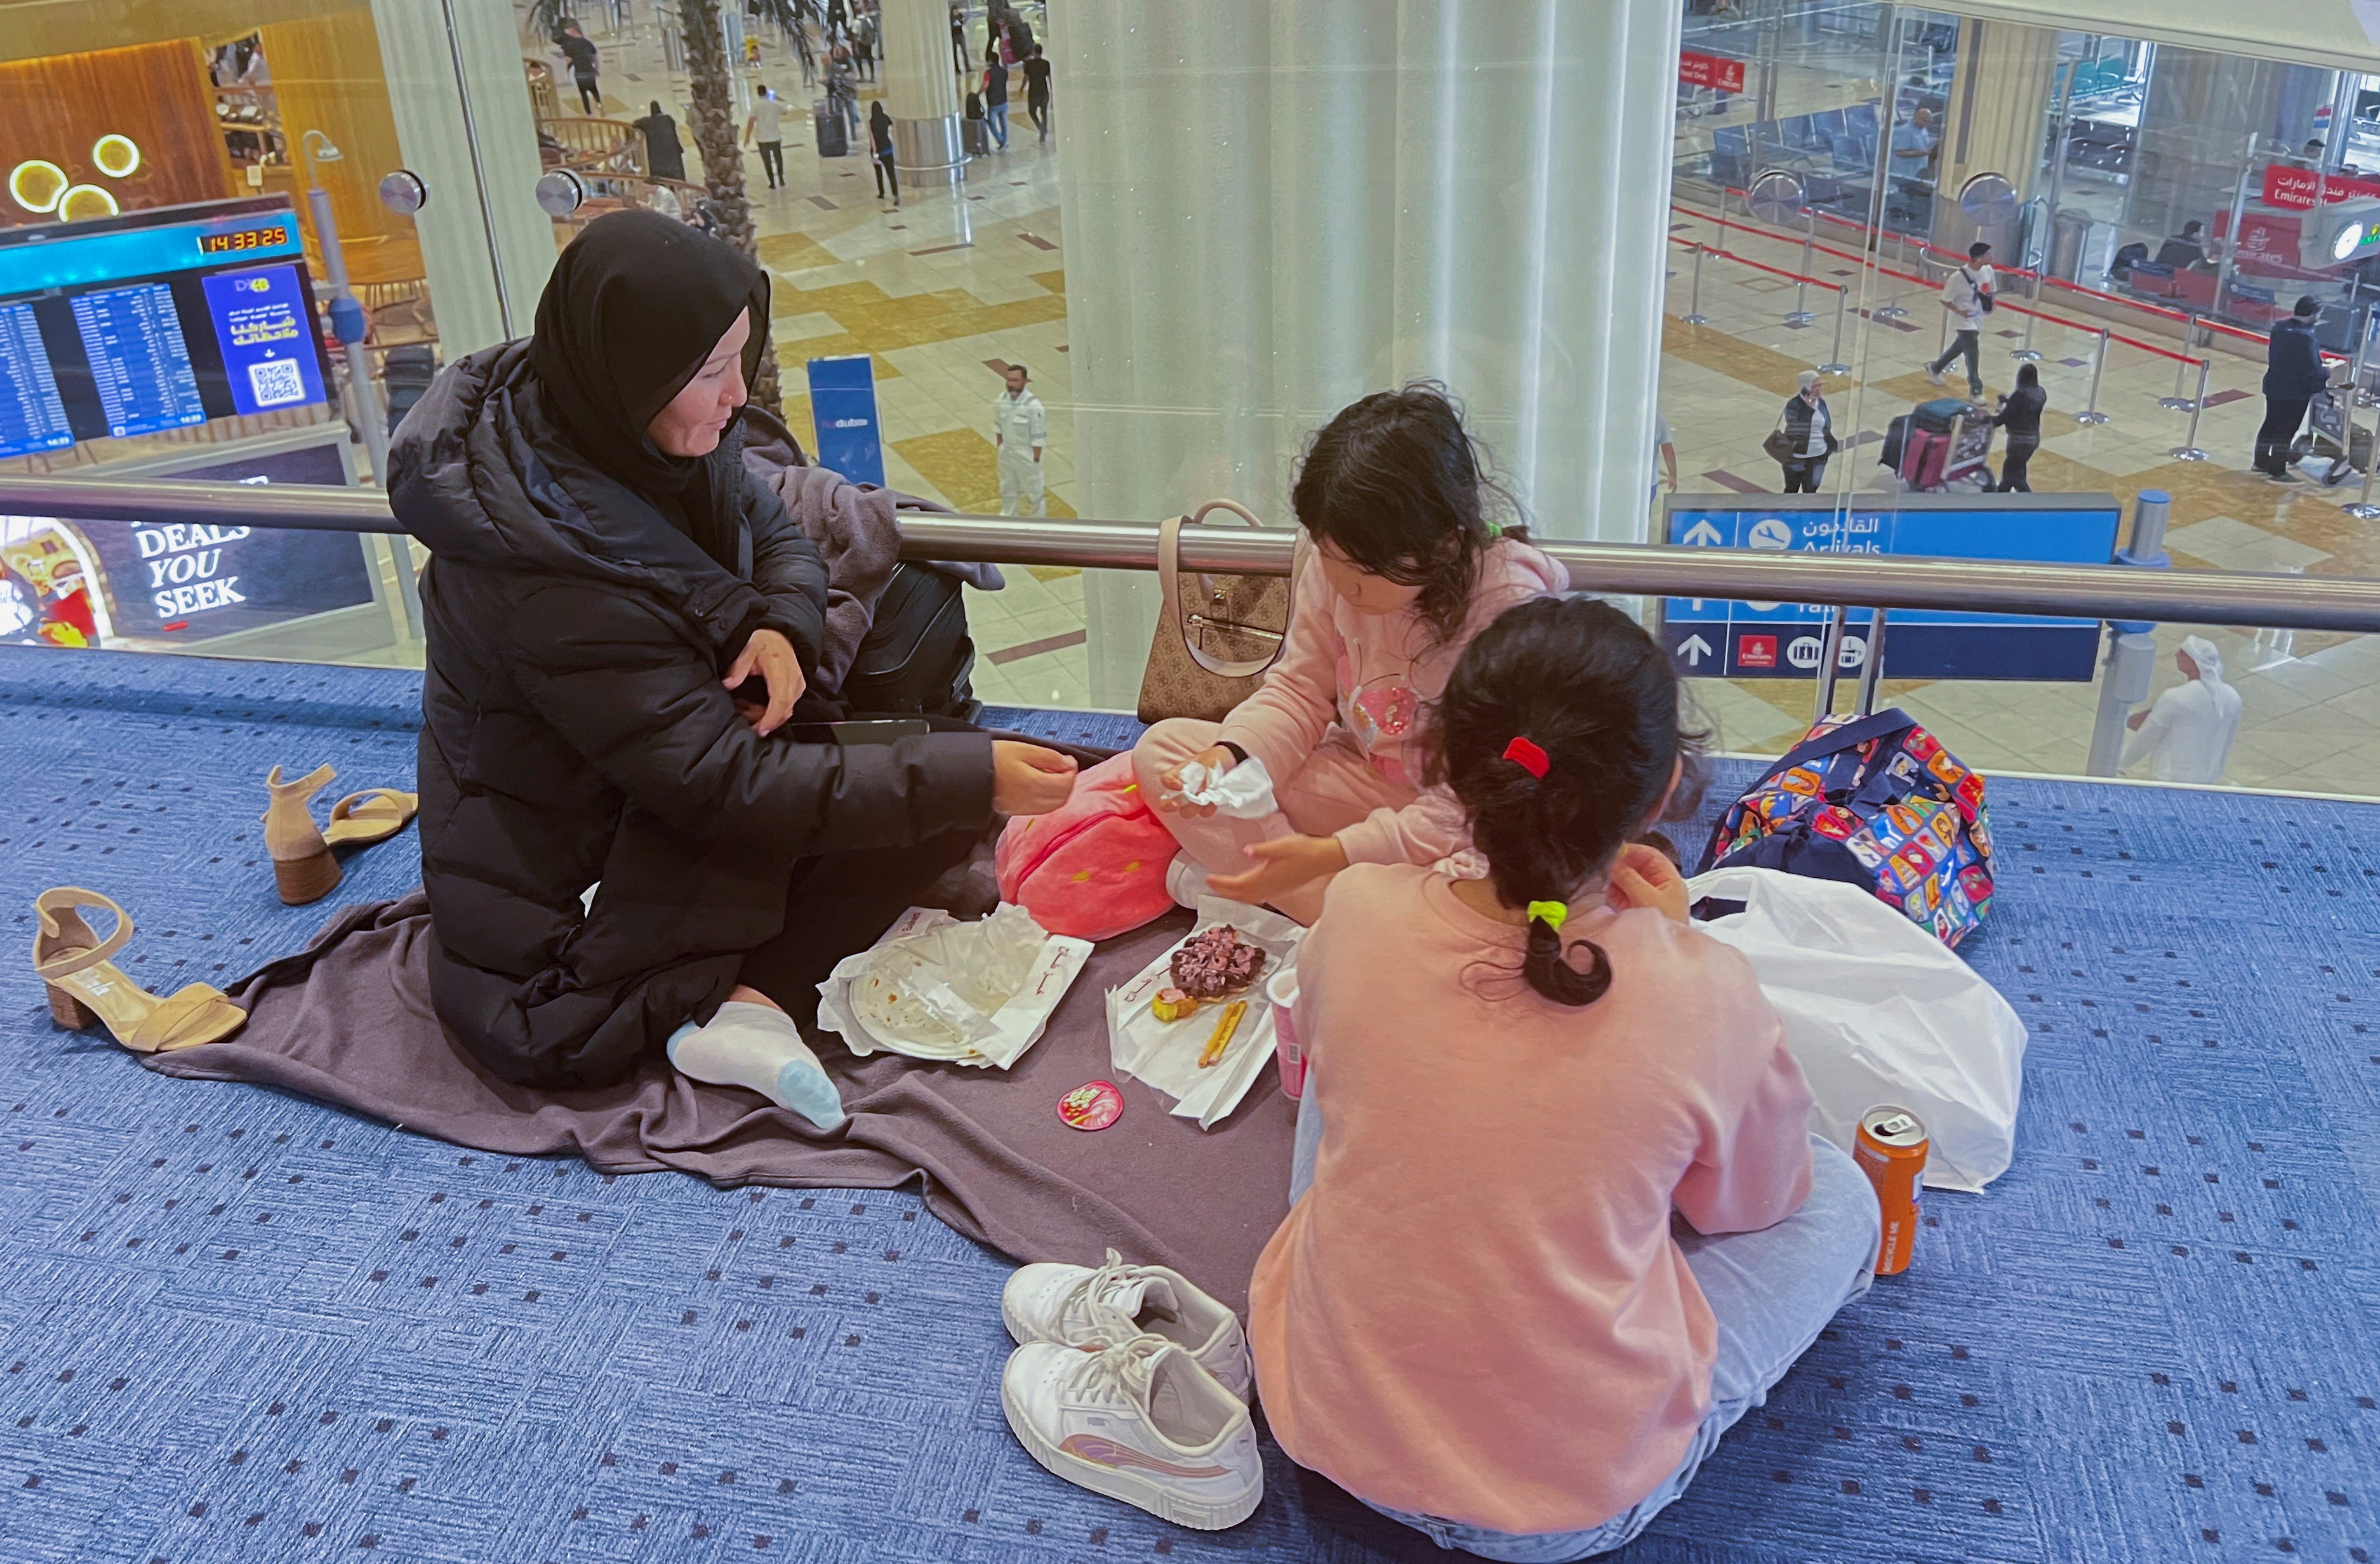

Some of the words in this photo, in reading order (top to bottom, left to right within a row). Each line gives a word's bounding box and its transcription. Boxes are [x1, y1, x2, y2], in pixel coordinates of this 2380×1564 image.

[2274, 189, 2315, 206] Emirates
[211, 236, 229, 252] 14
[234, 231, 257, 250] 33
[262, 227, 286, 246] 25
[149, 548, 222, 588] YOU
[156, 576, 247, 618] SEEK
[1882, 1234, 1898, 1273] RECYCLE
